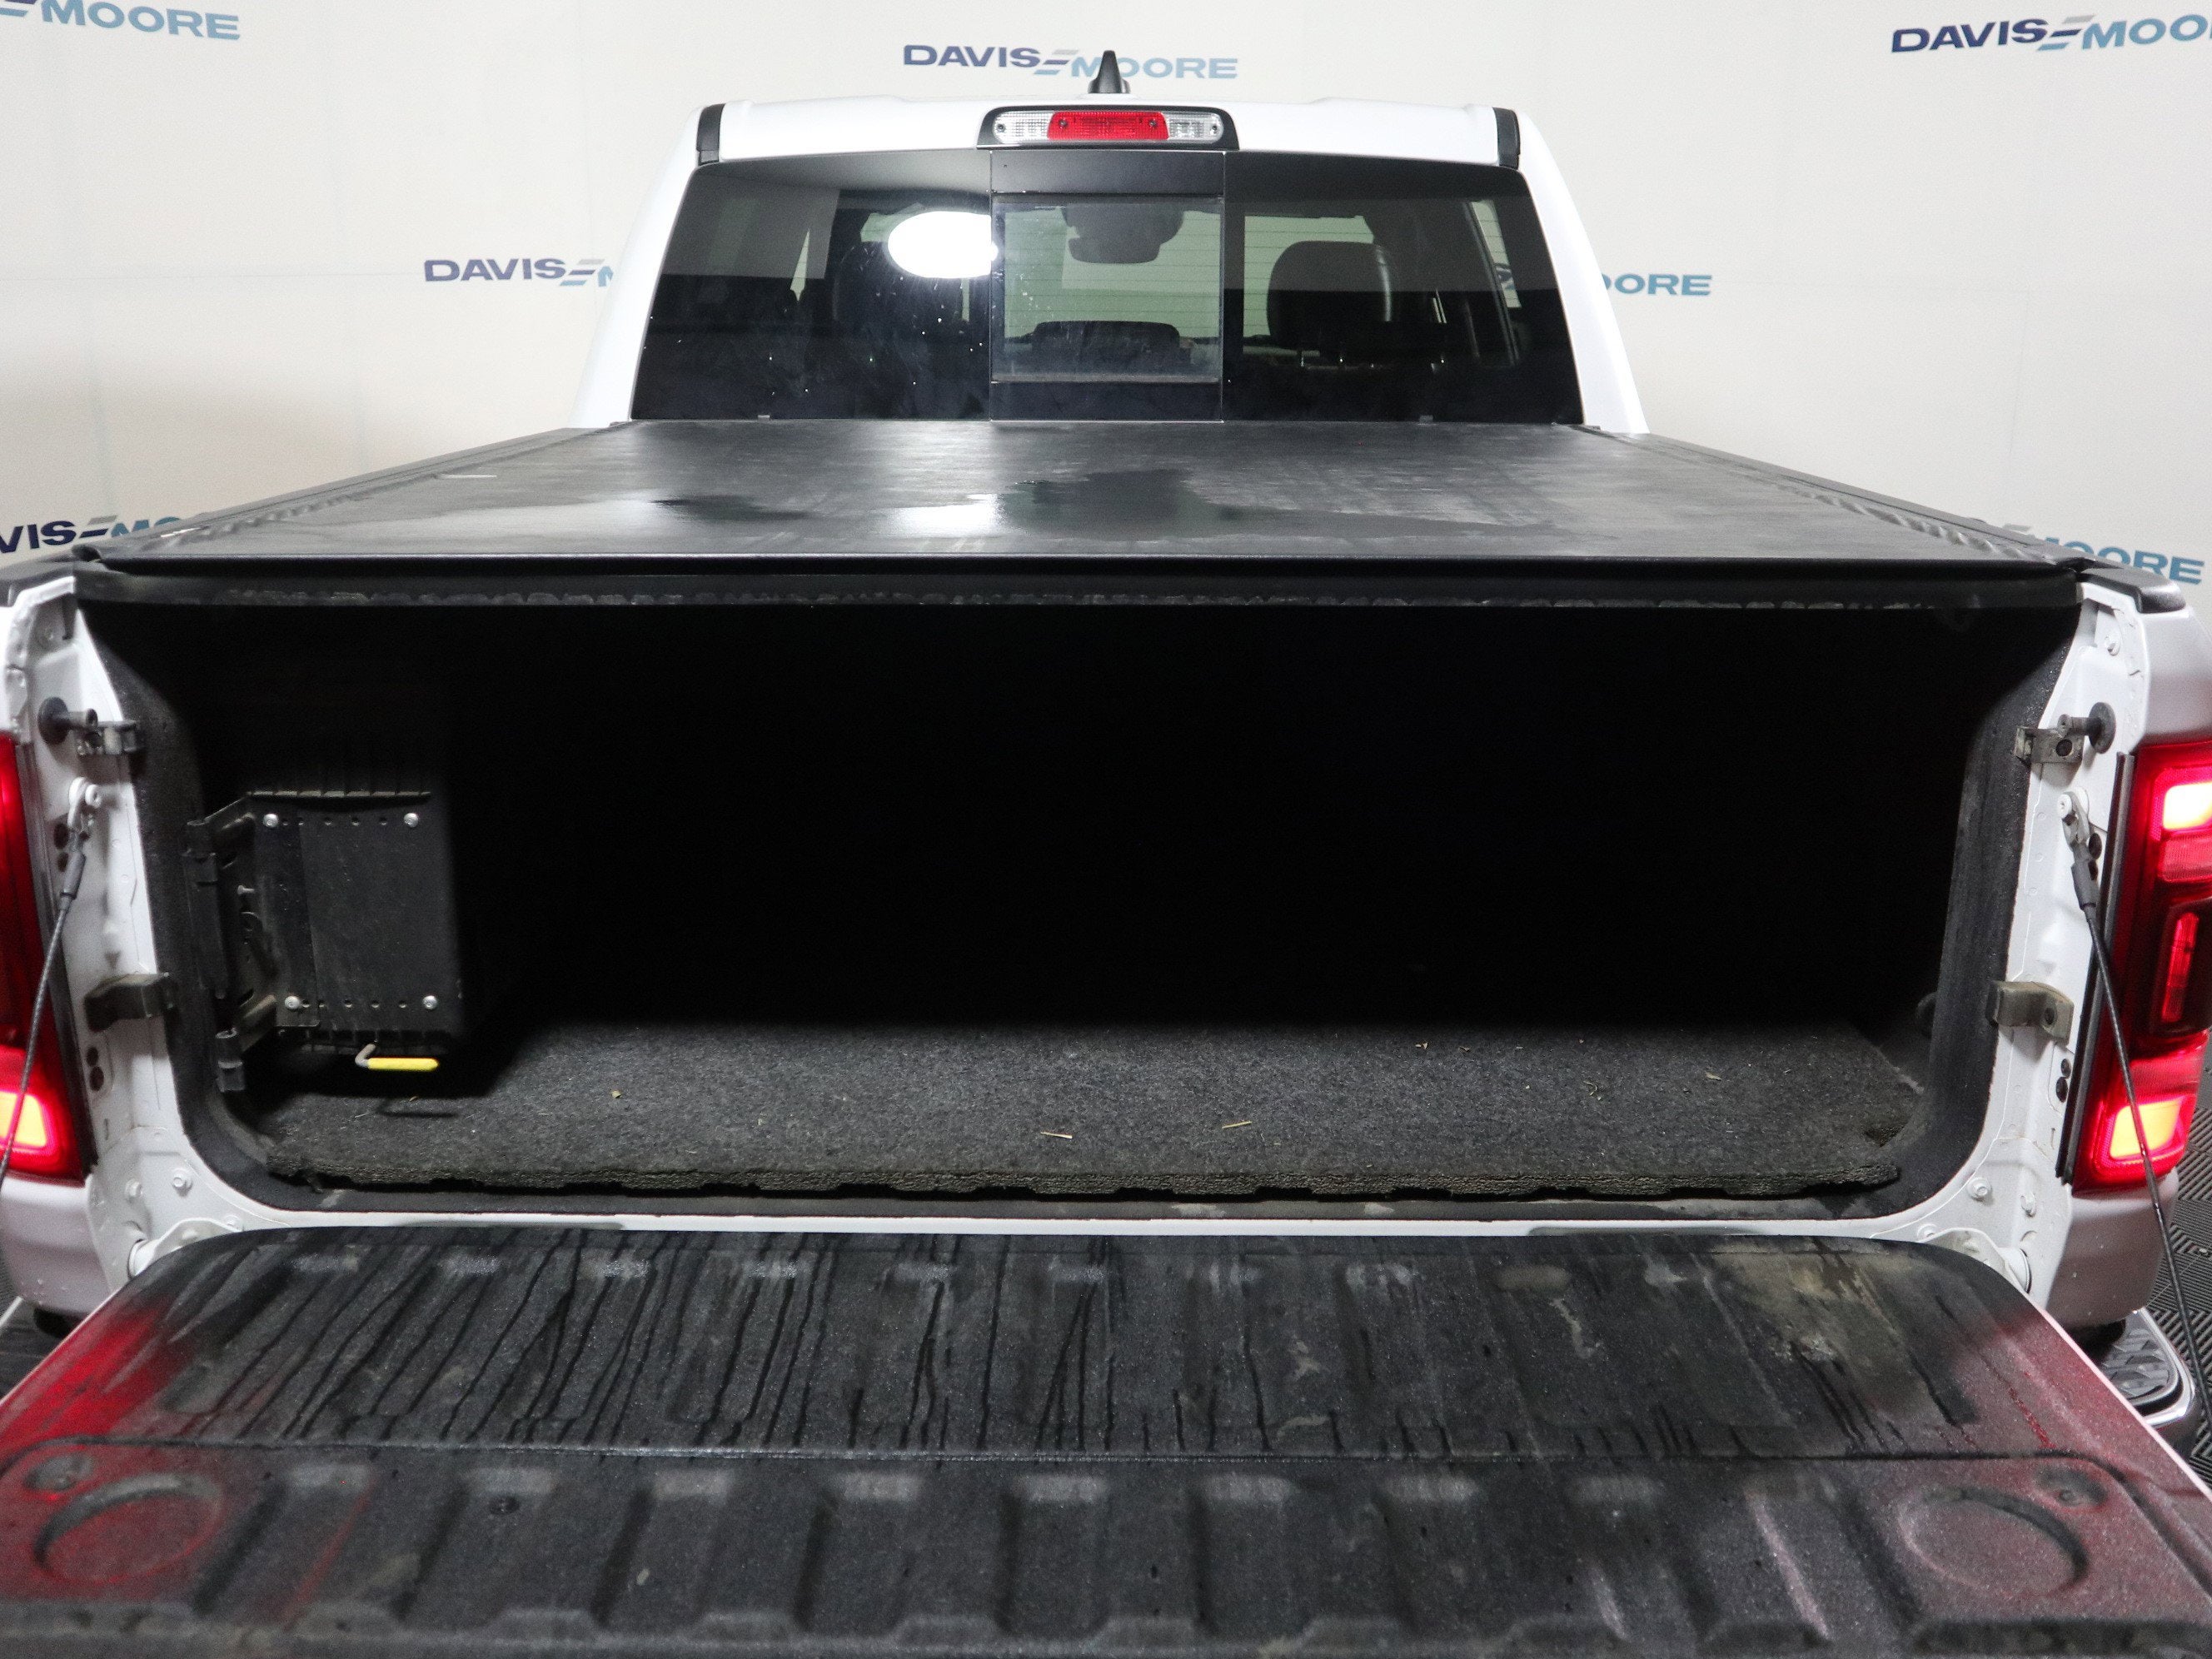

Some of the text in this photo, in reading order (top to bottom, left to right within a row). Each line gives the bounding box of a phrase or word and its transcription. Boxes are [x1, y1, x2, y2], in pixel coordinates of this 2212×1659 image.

[41, 0, 241, 40] MOORE
[1891, 13, 2212, 52] DAVIS MOO
[904, 45, 1040, 67] DAVIS
[424, 258, 566, 281] DAVIS
[1602, 273, 1712, 296] ORE
[0, 521, 77, 554] VIS
